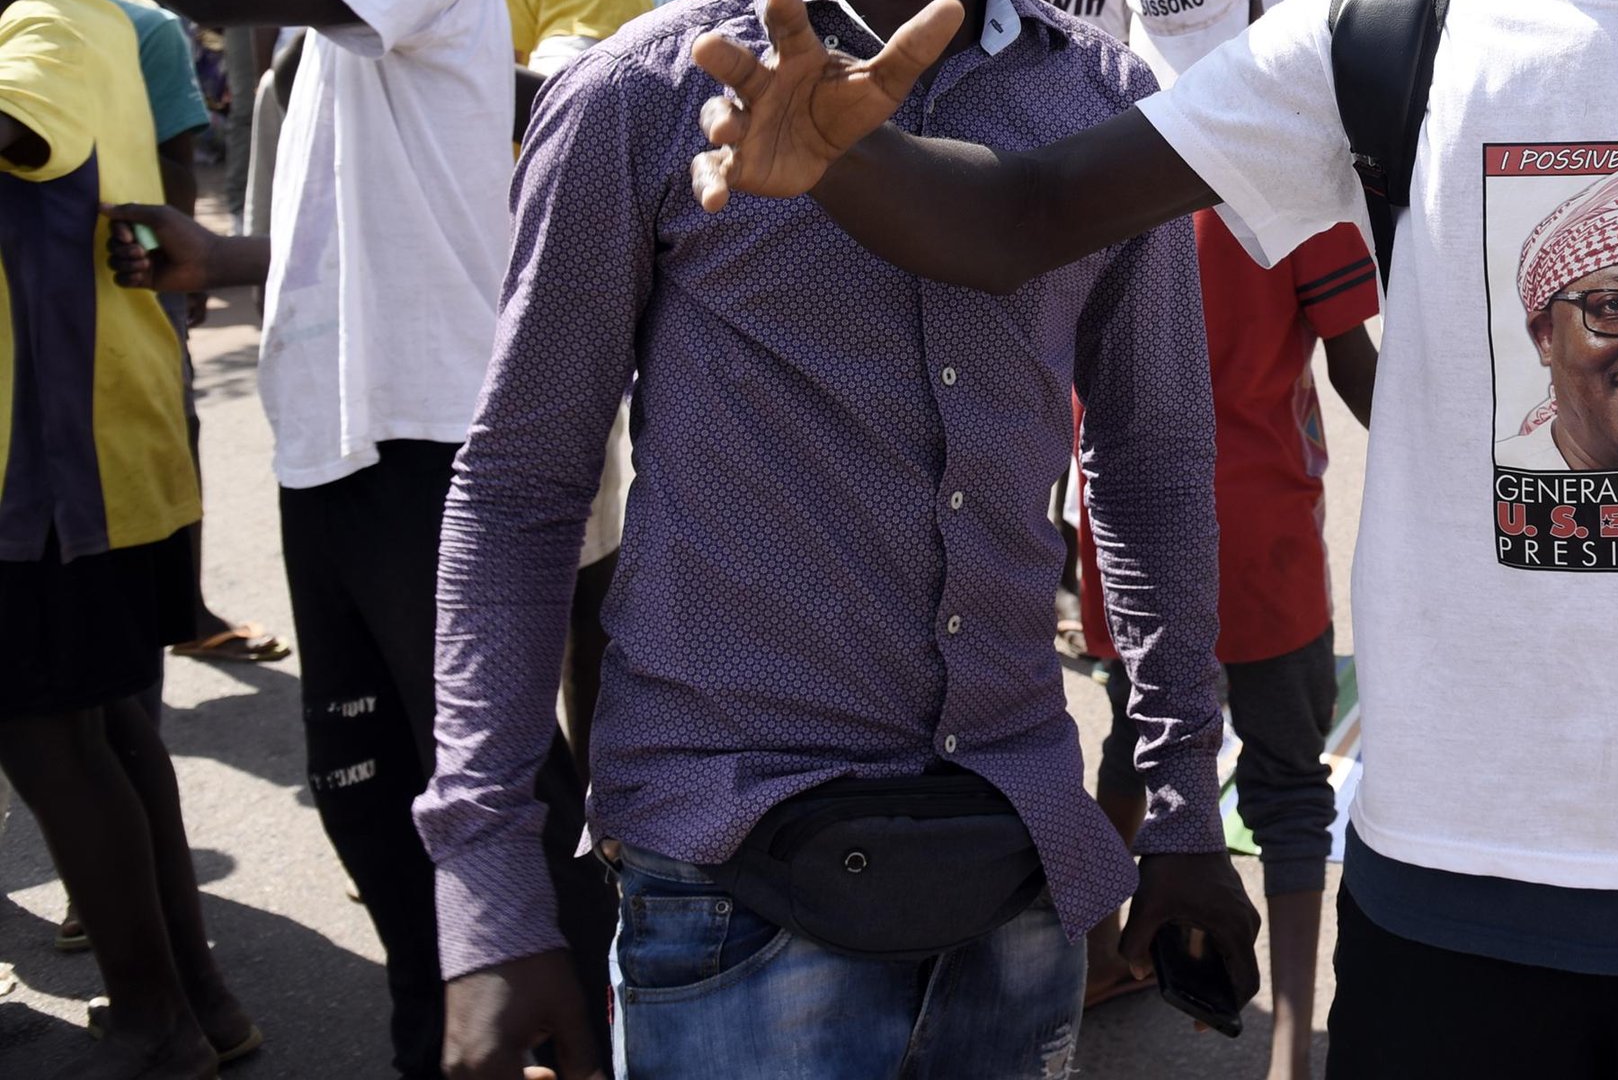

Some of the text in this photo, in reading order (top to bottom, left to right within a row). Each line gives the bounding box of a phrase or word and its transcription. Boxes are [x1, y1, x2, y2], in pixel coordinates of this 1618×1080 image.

[1501, 151, 1510, 170] I
[1497, 500, 1538, 537] U.
[1549, 504, 1589, 539] S.
